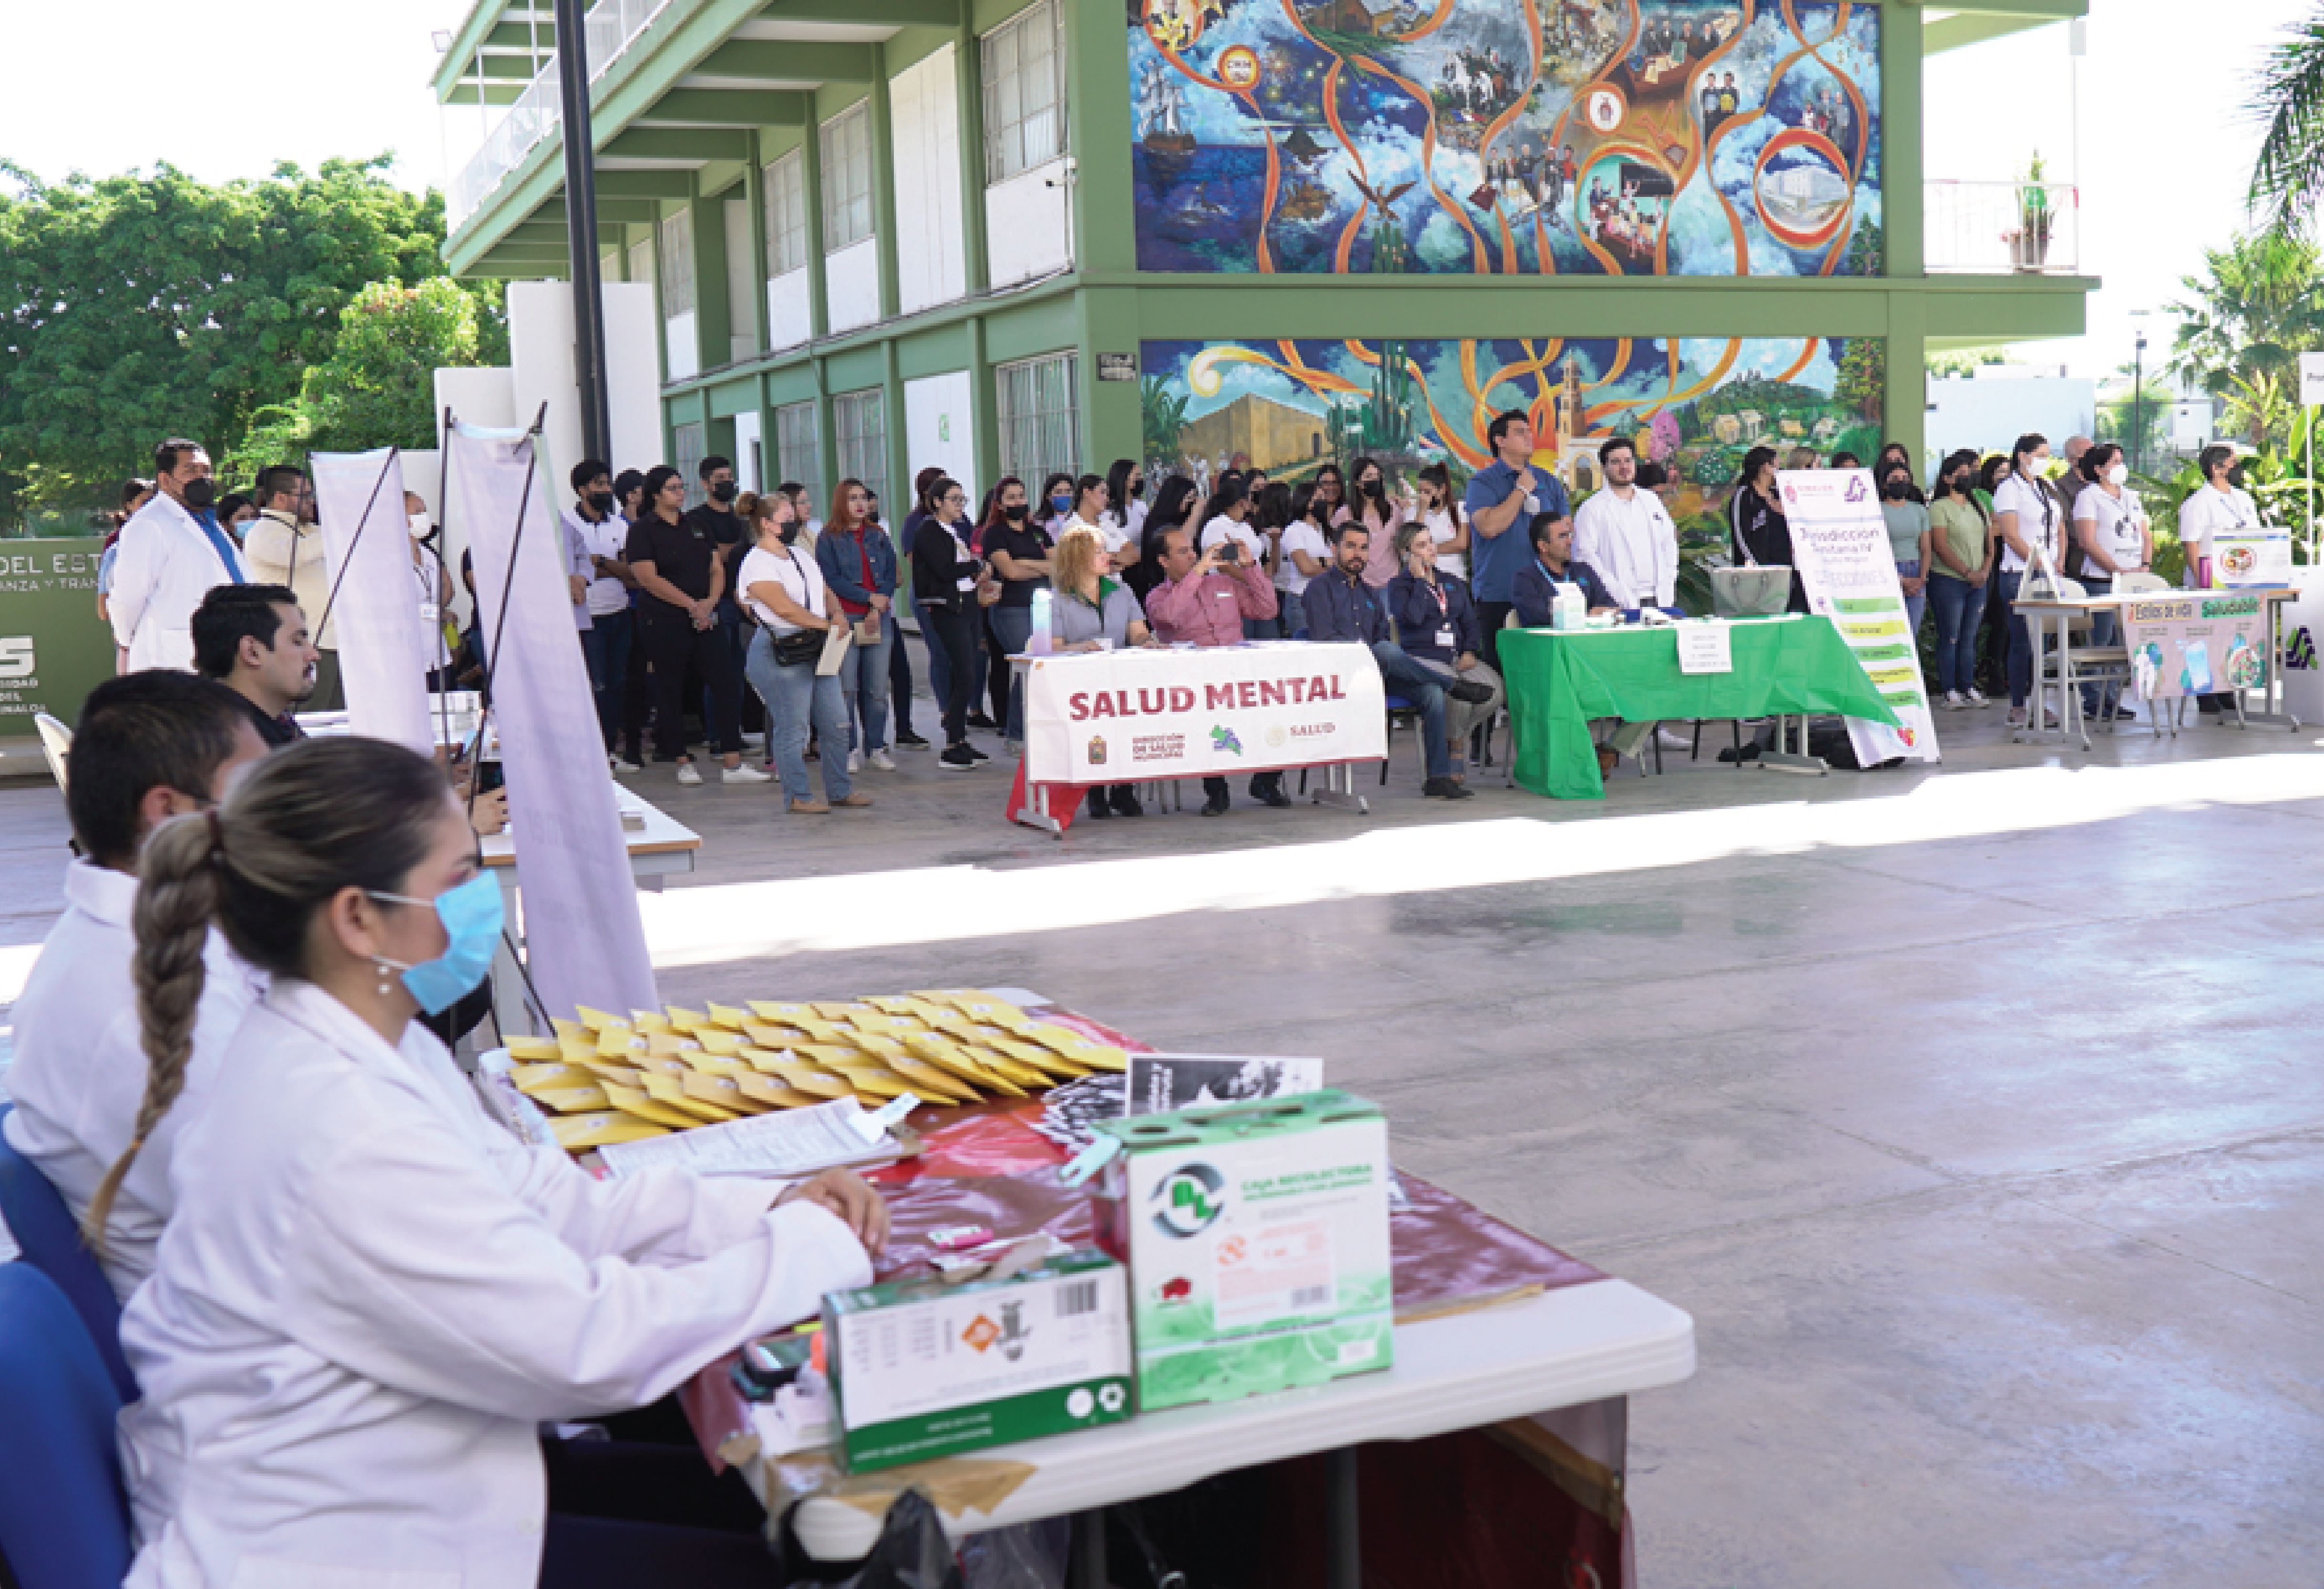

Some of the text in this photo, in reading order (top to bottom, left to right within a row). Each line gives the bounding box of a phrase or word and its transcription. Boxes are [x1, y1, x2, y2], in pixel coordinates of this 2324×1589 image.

[1069, 674, 1346, 721] SALUD MENTAL
[1290, 721, 1336, 737] SALUD
